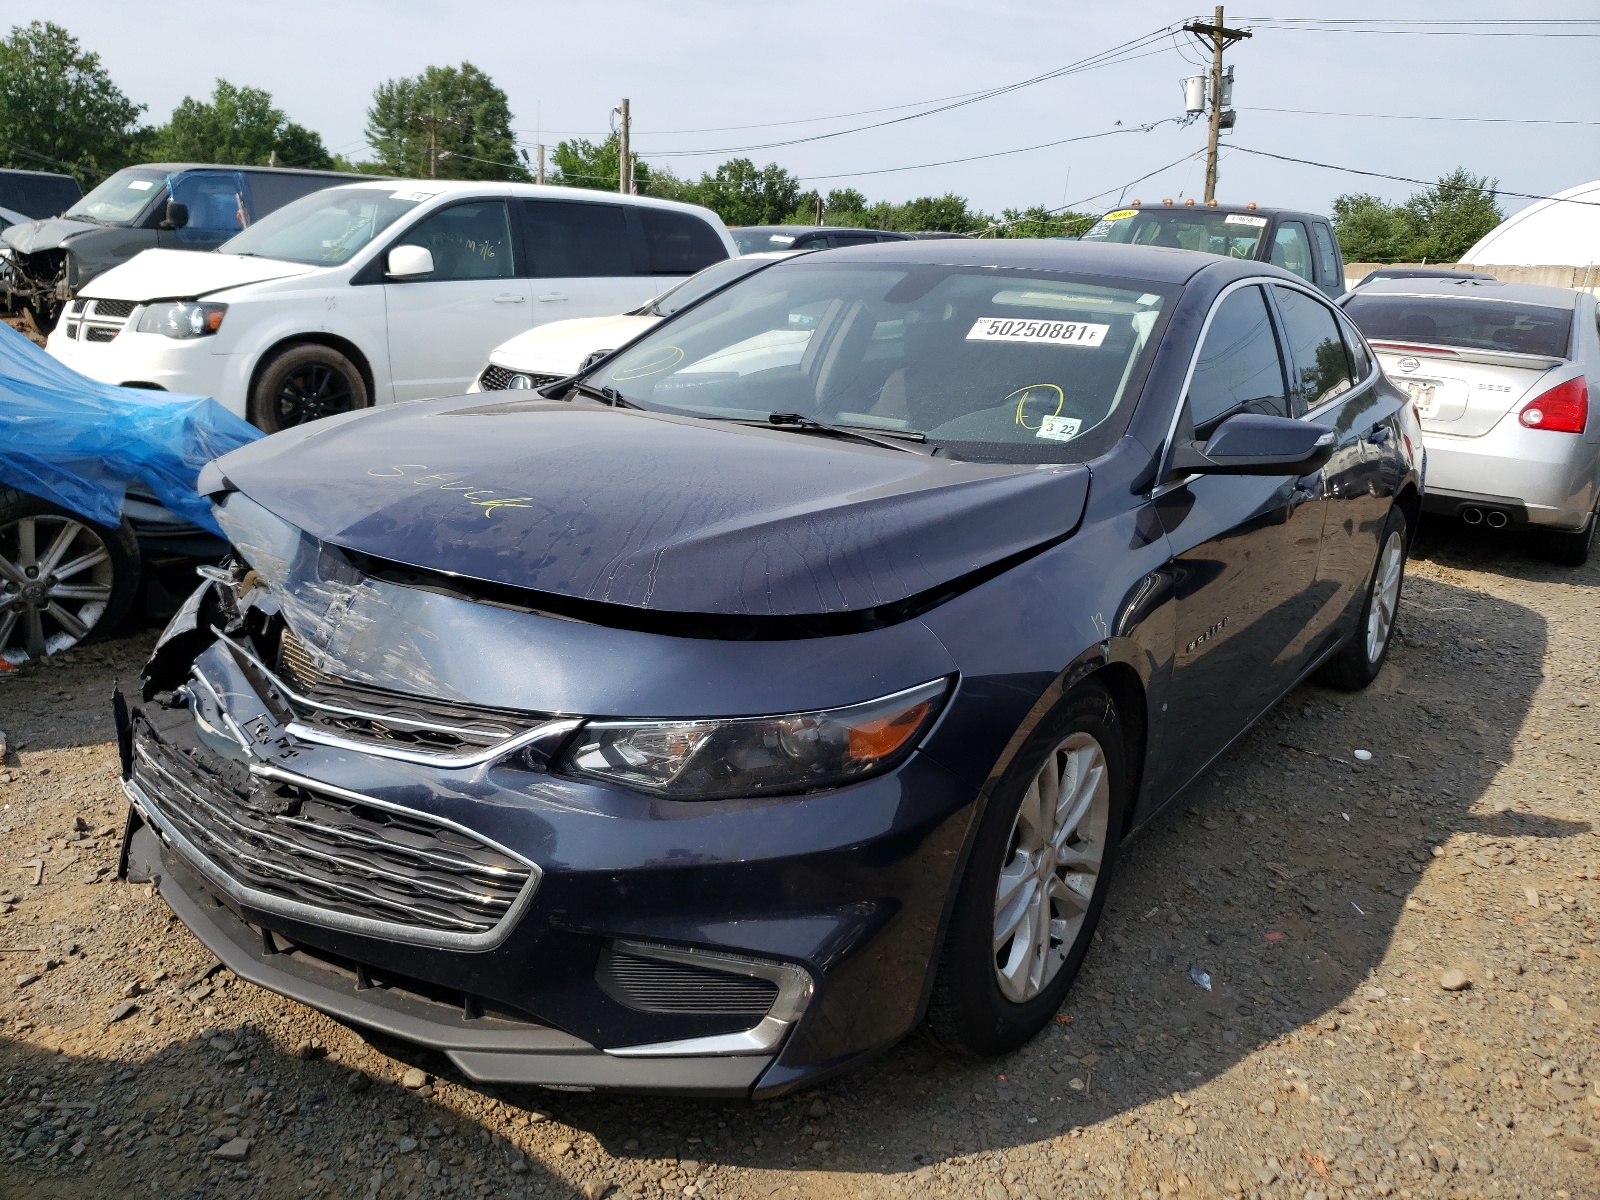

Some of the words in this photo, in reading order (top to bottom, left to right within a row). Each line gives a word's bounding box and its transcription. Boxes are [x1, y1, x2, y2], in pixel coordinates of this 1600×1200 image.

[986, 320, 1089, 341] 50250881
[1088, 331, 1098, 340] F
[1045, 422, 1055, 432] 3
[1059, 424, 1075, 435] 22
[1186, 616, 1230, 654] MALIBU
